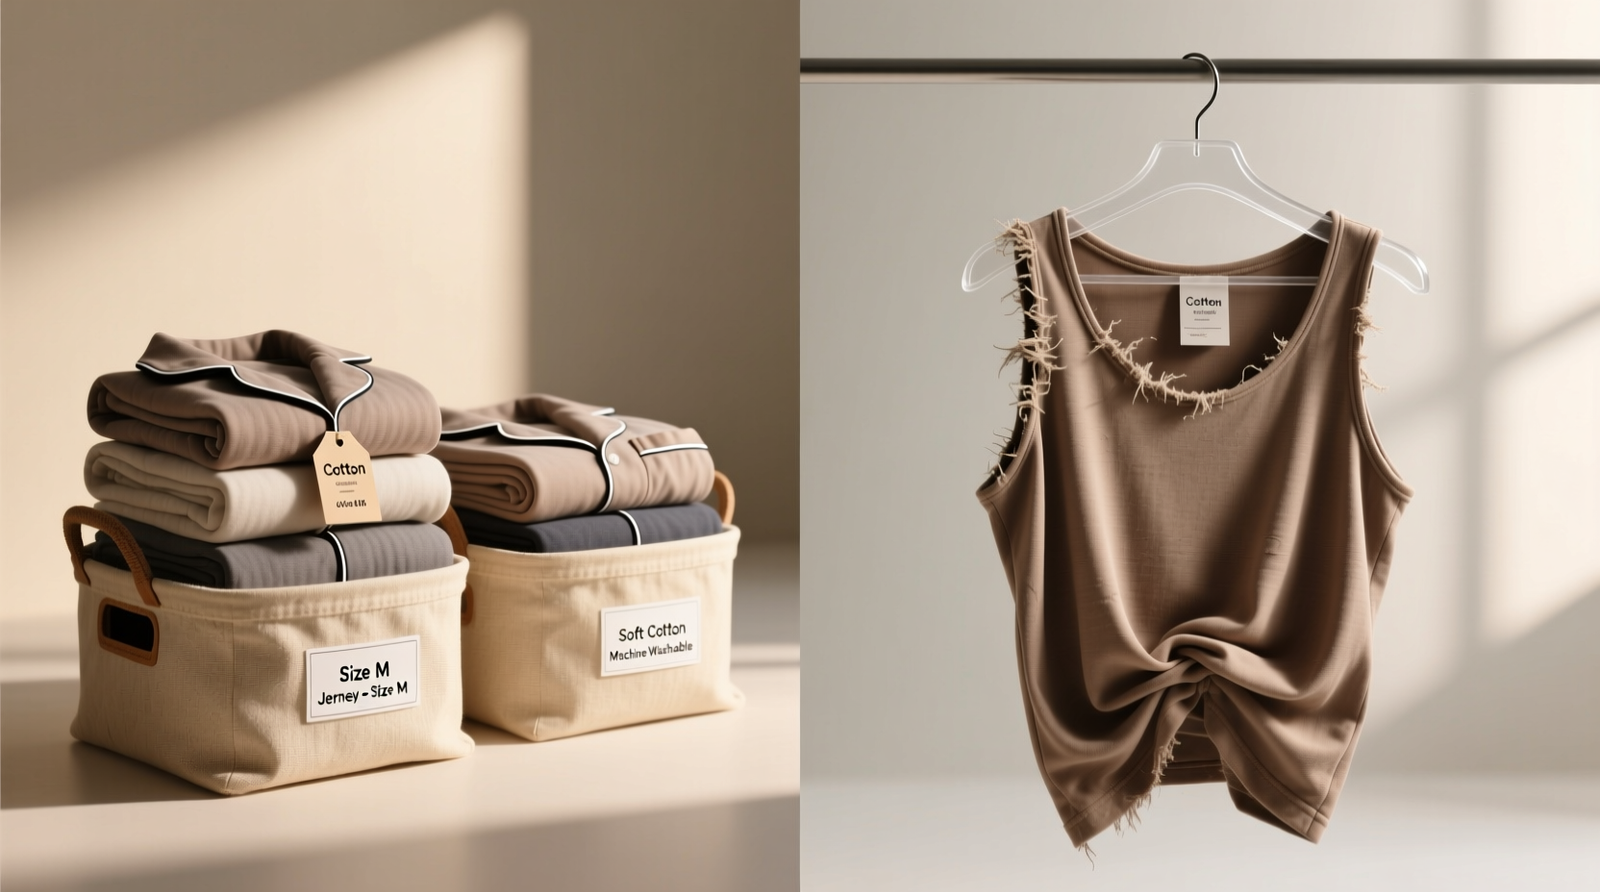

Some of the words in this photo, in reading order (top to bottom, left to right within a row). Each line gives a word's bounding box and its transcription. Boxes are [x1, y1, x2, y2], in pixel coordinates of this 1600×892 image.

[1186, 296, 1222, 307] Cotton
[323, 463, 366, 476] Cotton
[618, 626, 644, 642] Soft
[647, 622, 686, 638] Cotton
[340, 664, 370, 682] Size
[376, 660, 390, 678] M
[370, 684, 394, 698] Size
[396, 680, 408, 694] M
